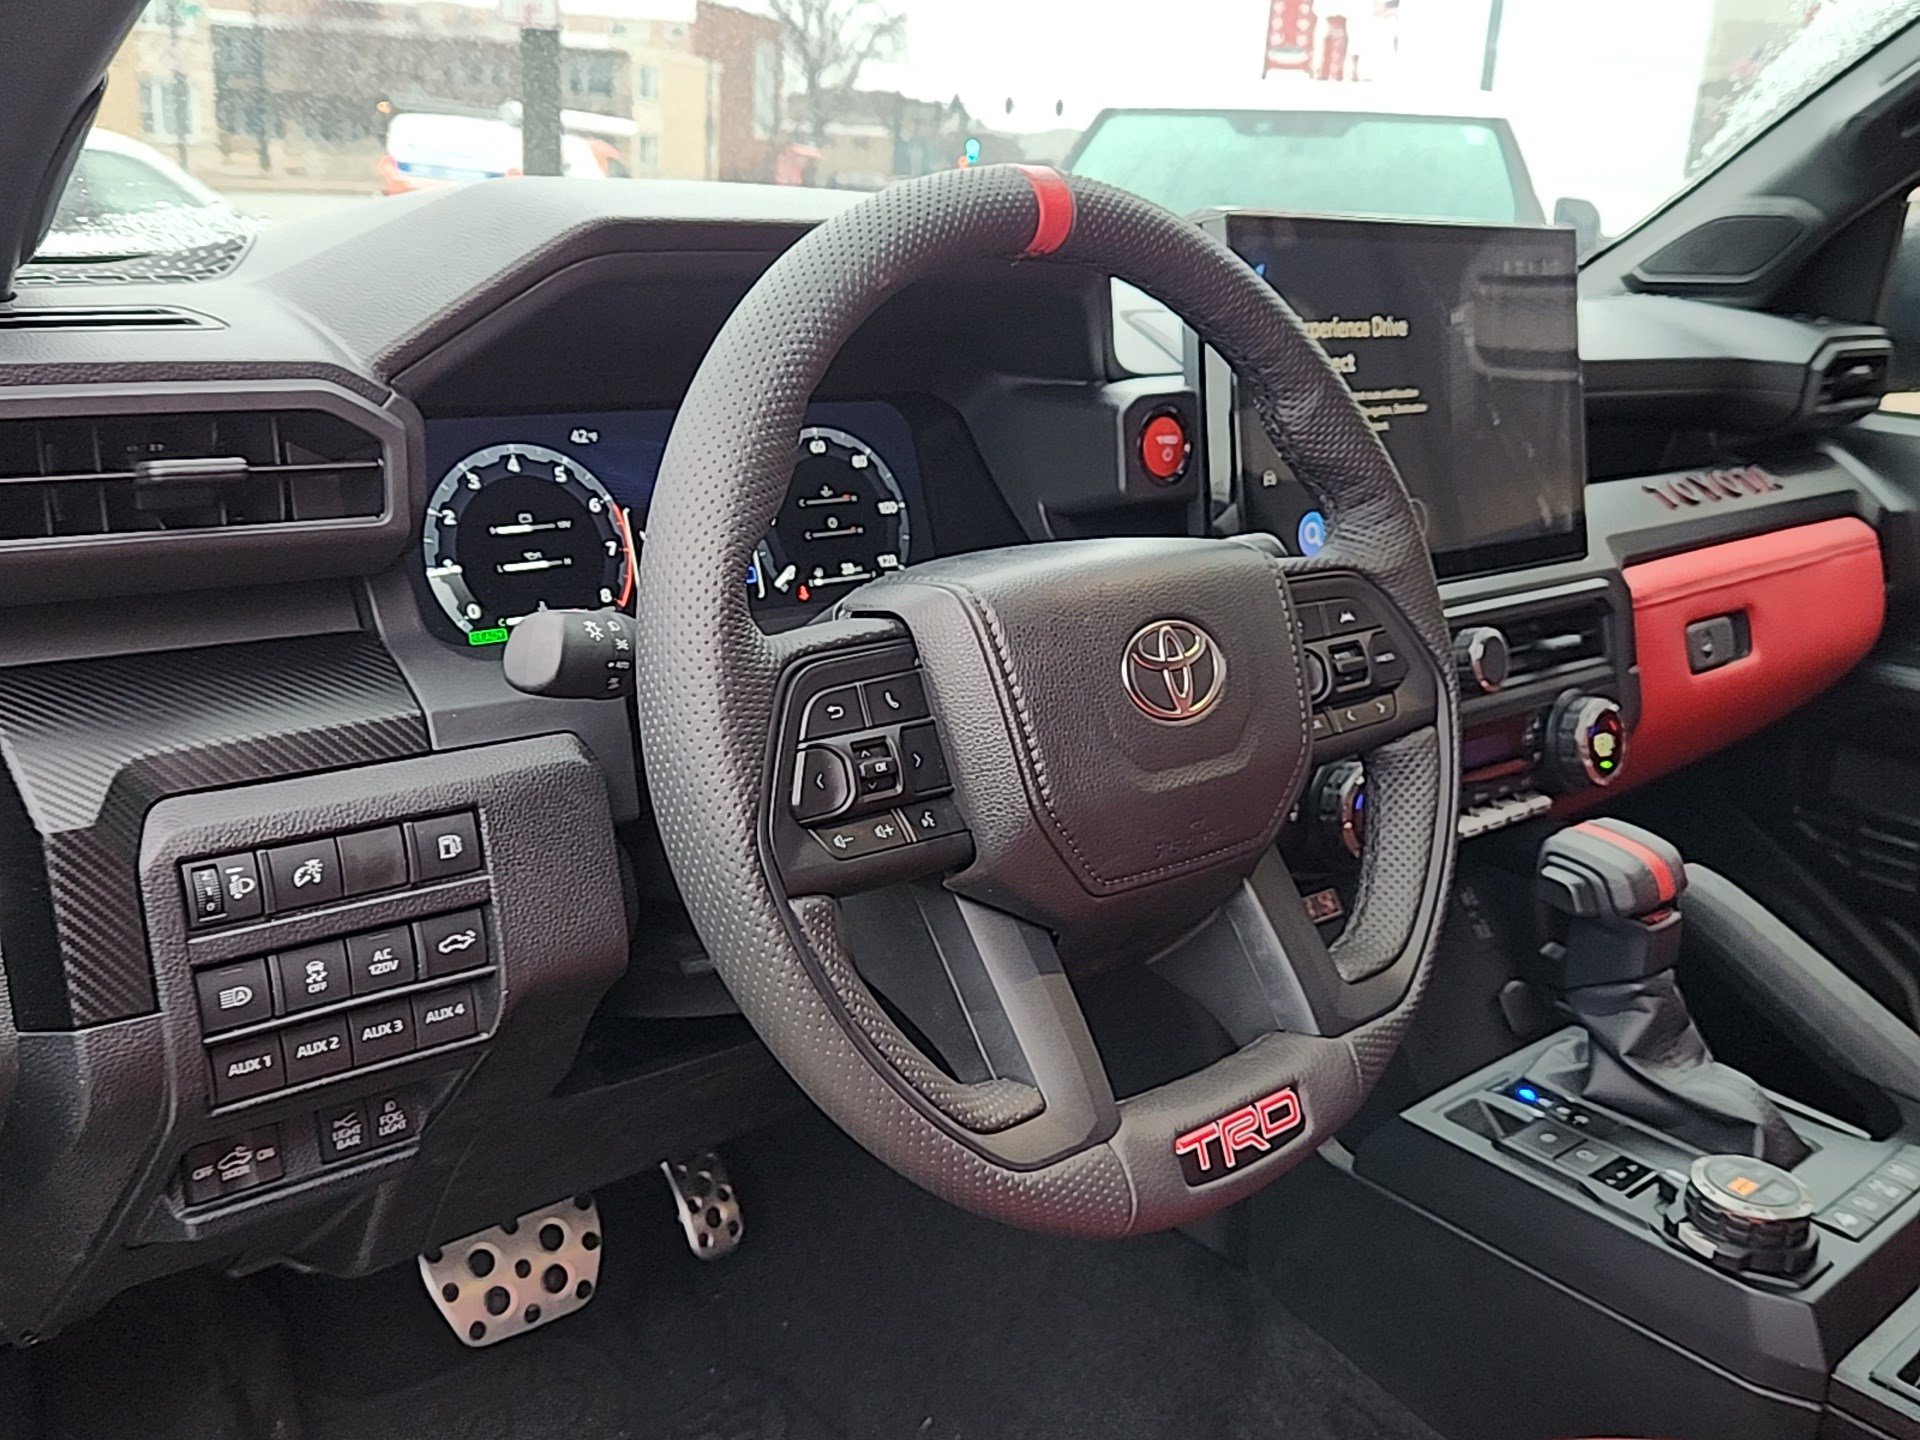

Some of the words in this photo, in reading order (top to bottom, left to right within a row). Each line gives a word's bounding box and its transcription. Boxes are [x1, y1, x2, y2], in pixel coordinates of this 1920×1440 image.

[1371, 315, 1409, 338] Drive
[508, 456, 522, 474] 4
[467, 473, 482, 490] 3
[554, 465, 568, 483] 5
[588, 497, 602, 514] 6
[442, 509, 458, 526] 2
[604, 540, 618, 557] 7
[599, 588, 613, 603] 8
[466, 603, 482, 620] 0
[372, 947, 393, 962] AC
[367, 959, 400, 976] 120V
[425, 1005, 455, 1024] AUX
[453, 1002, 466, 1016] 4
[361, 1025, 392, 1041] AUX
[391, 1019, 404, 1033] 3
[296, 1041, 329, 1059] AUX
[328, 1036, 341, 1050] 2
[227, 1059, 261, 1077] AUX
[262, 1054, 273, 1069] 1
[379, 1109, 405, 1126] FOG
[1174, 1086, 1302, 1171] TRD
[335, 1134, 362, 1151] BAR
